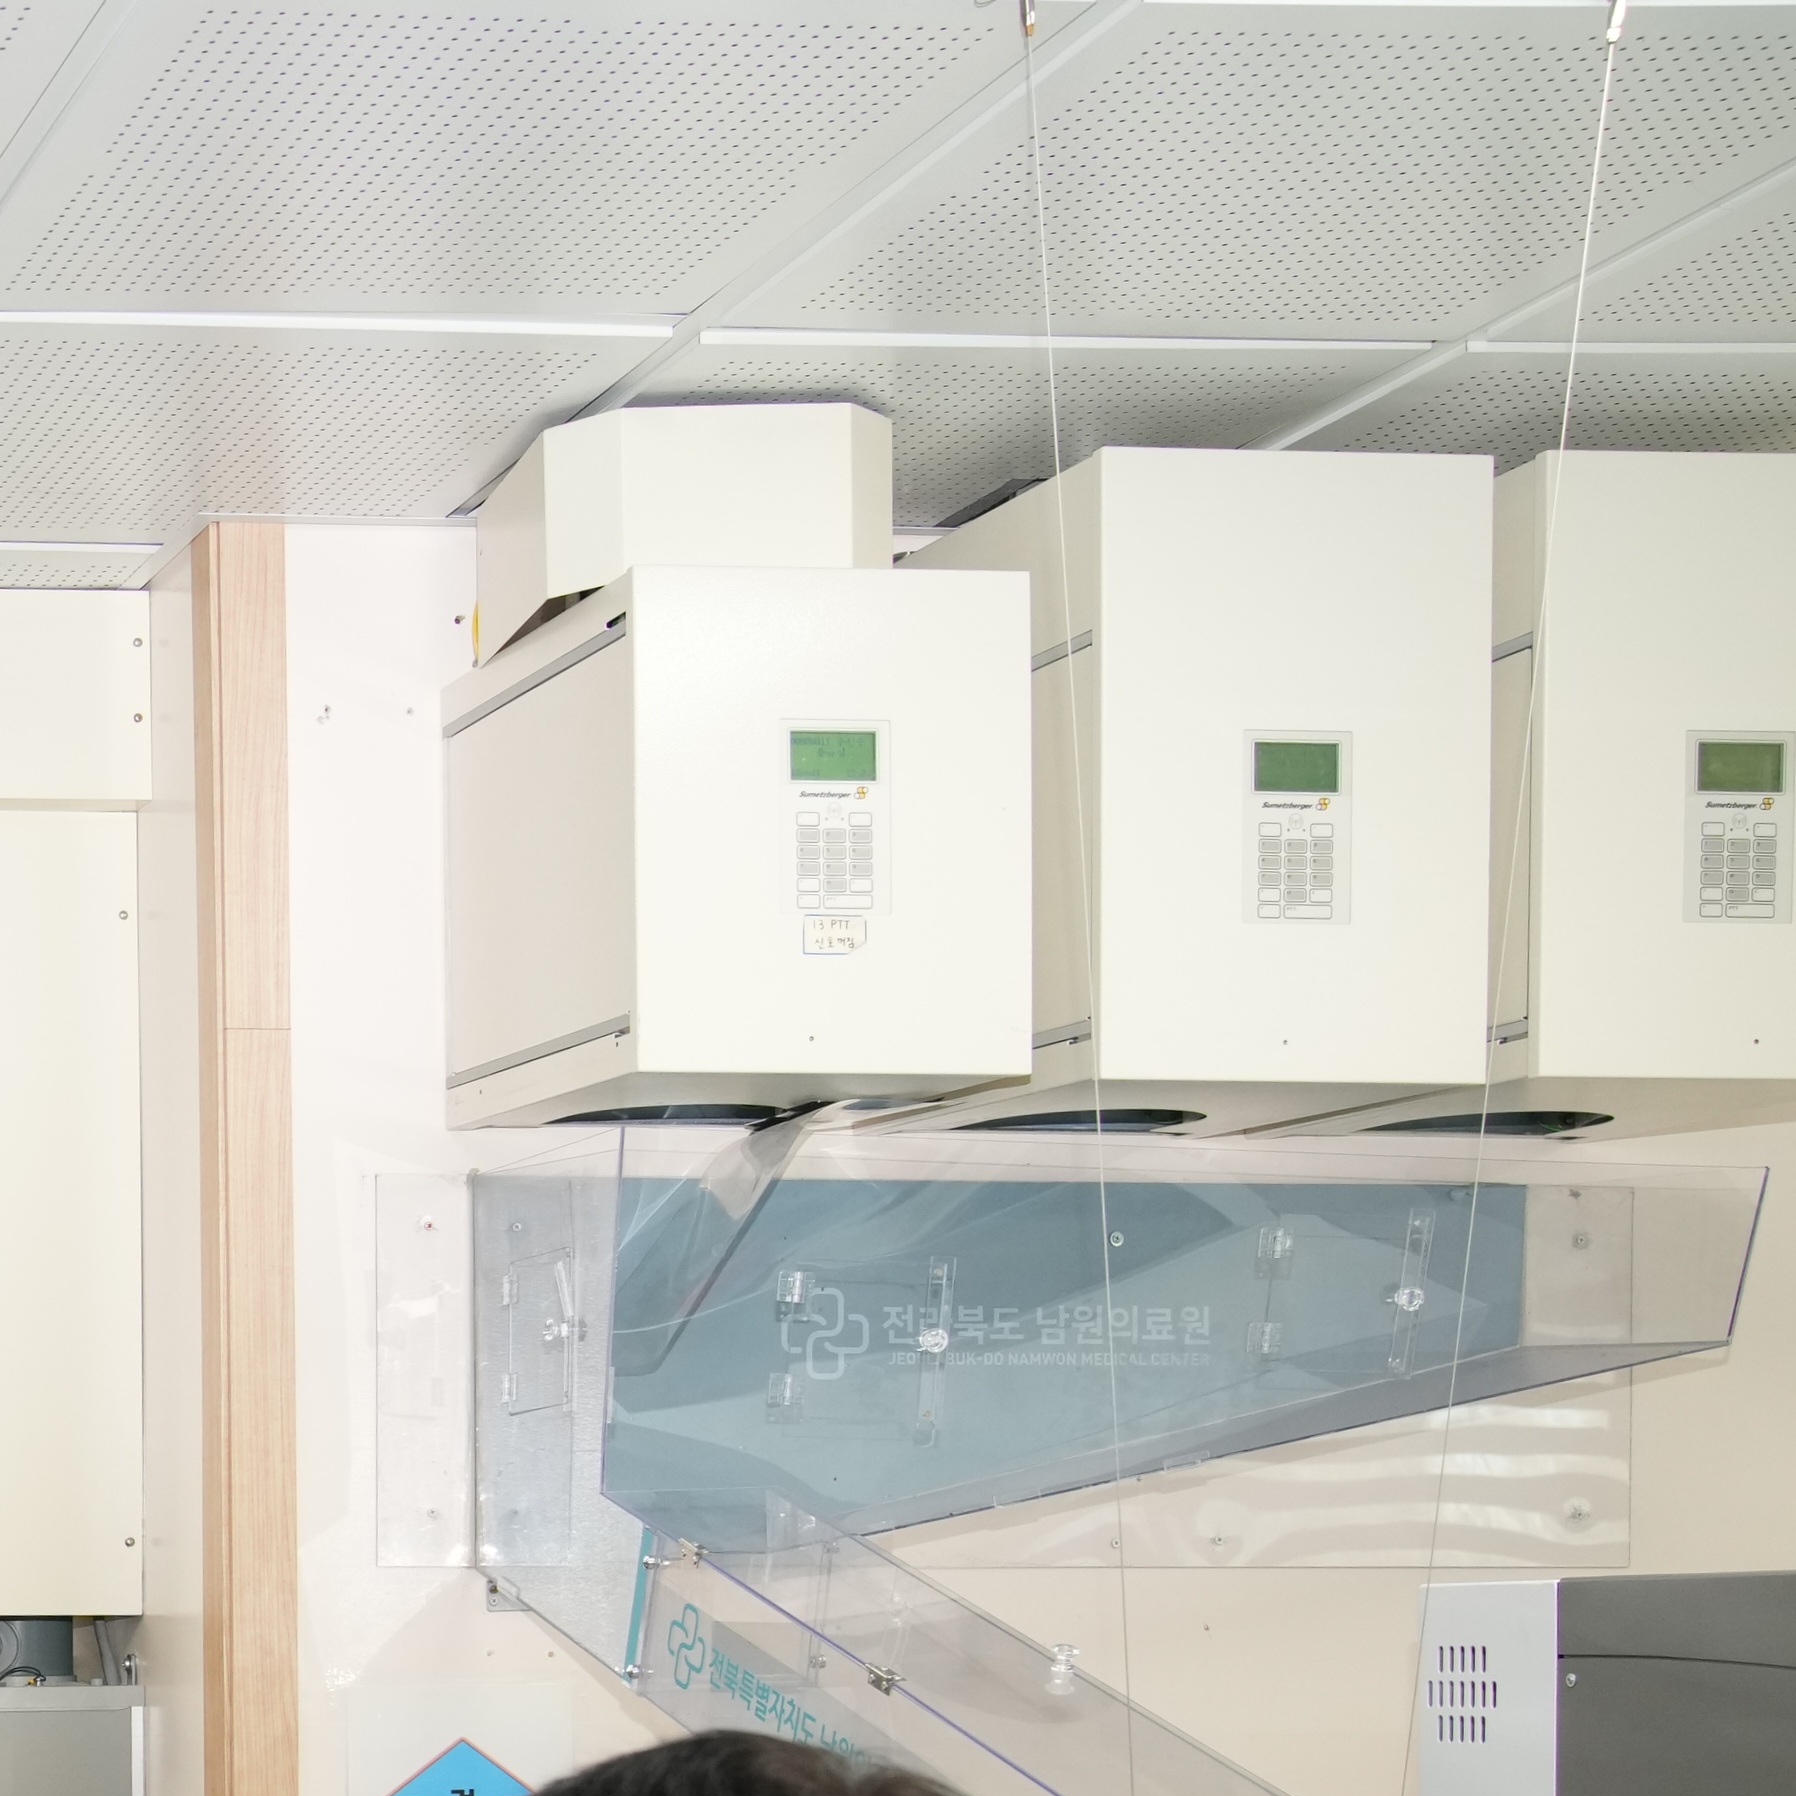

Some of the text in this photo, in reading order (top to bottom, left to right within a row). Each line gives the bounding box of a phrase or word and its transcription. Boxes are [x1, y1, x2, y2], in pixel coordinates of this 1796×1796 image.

[799, 790, 851, 800] Sumetzberger
[1262, 801, 1313, 811] Sumetzberger
[1705, 801, 1758, 811] Sumetzberger
[812, 918, 850, 931] 13 PTT
[814, 936, 834, 950] 신호
[1035, 1304, 1211, 1347] 남원의료원
[1007, 1352, 1078, 1366] NAMWON
[1080, 1352, 1148, 1367] MEDICAL
[1150, 1352, 1211, 1367] CENTER
[709, 1648, 817, 1745] 전북특별자치도
